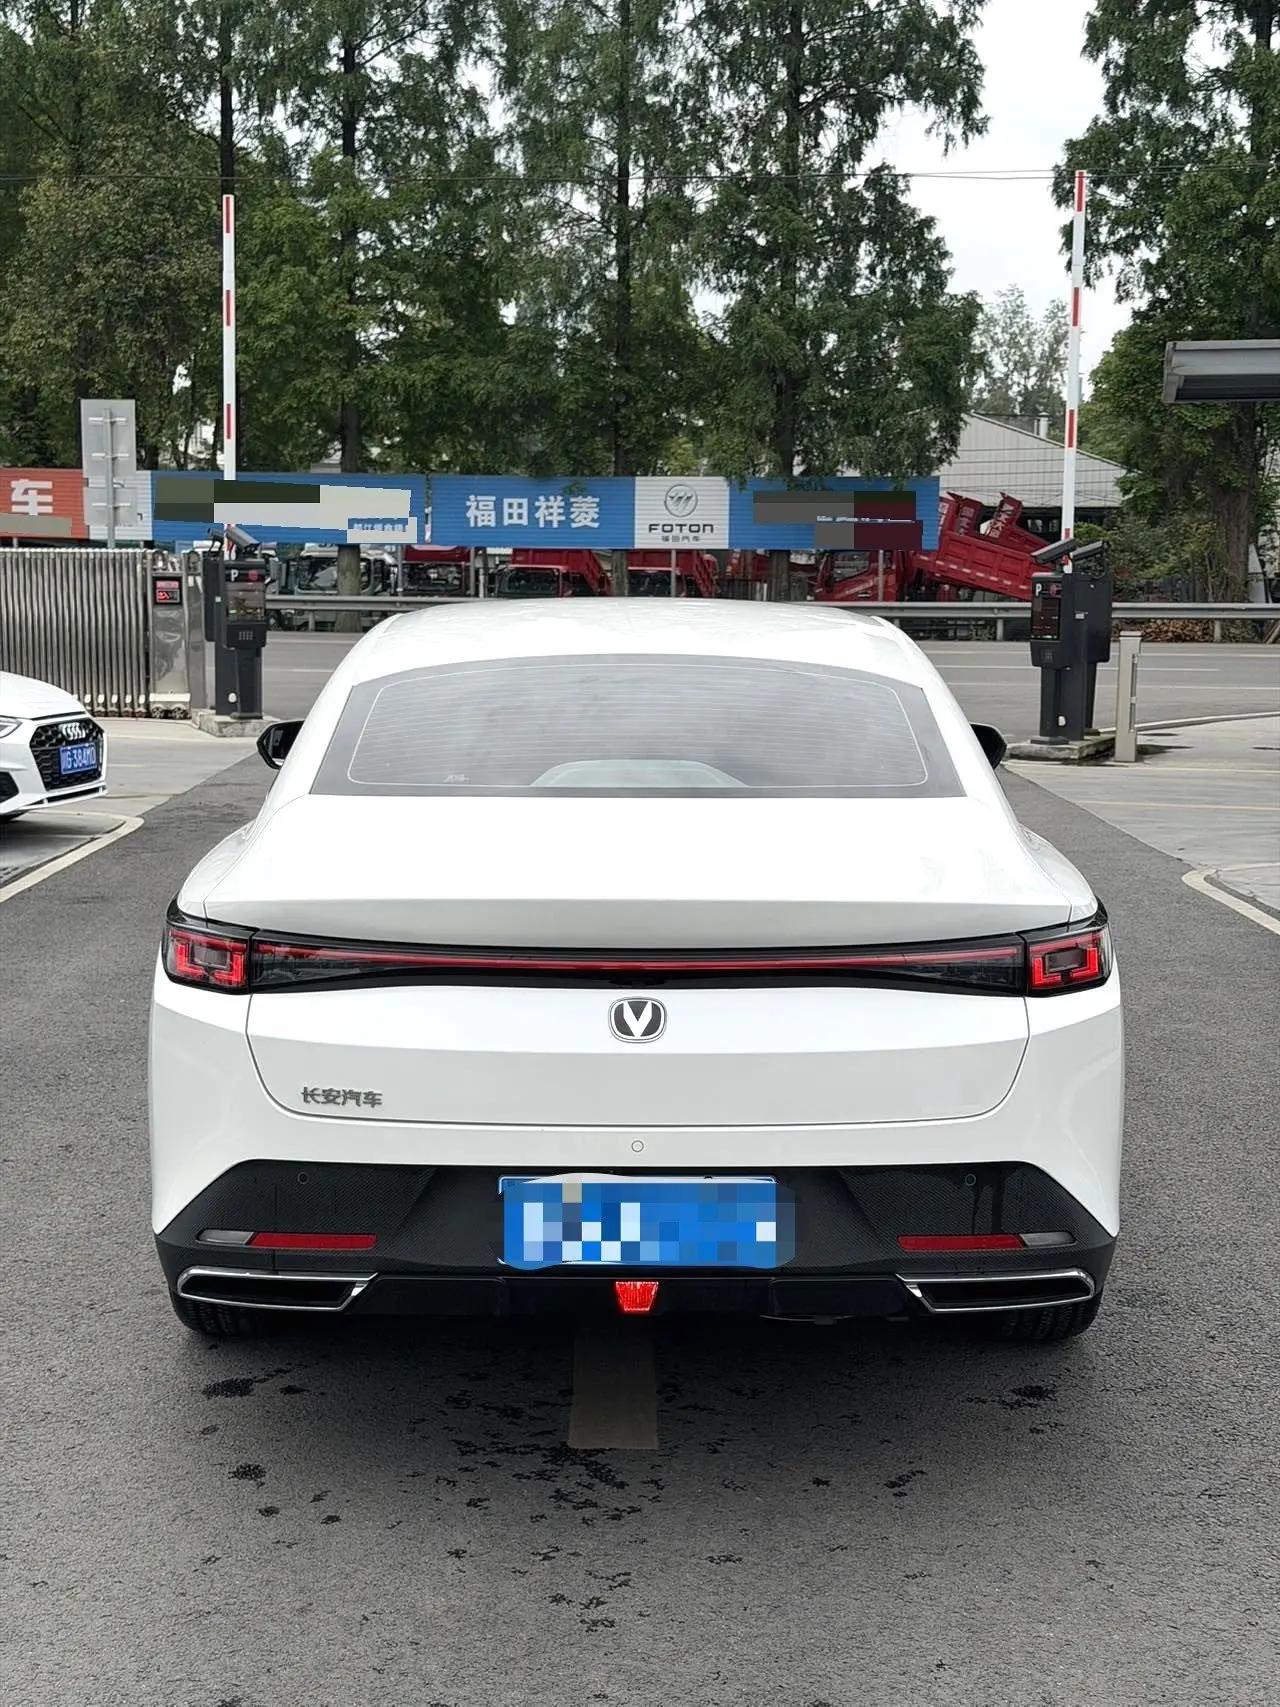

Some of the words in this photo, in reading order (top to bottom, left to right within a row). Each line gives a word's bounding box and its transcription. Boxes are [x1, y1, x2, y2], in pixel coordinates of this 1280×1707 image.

[10, 478, 54, 516] 车
[465, 495, 600, 529] 福田祥菱
[648, 523, 714, 534] FOTON
[301, 1086, 383, 1108] 长安汽车
